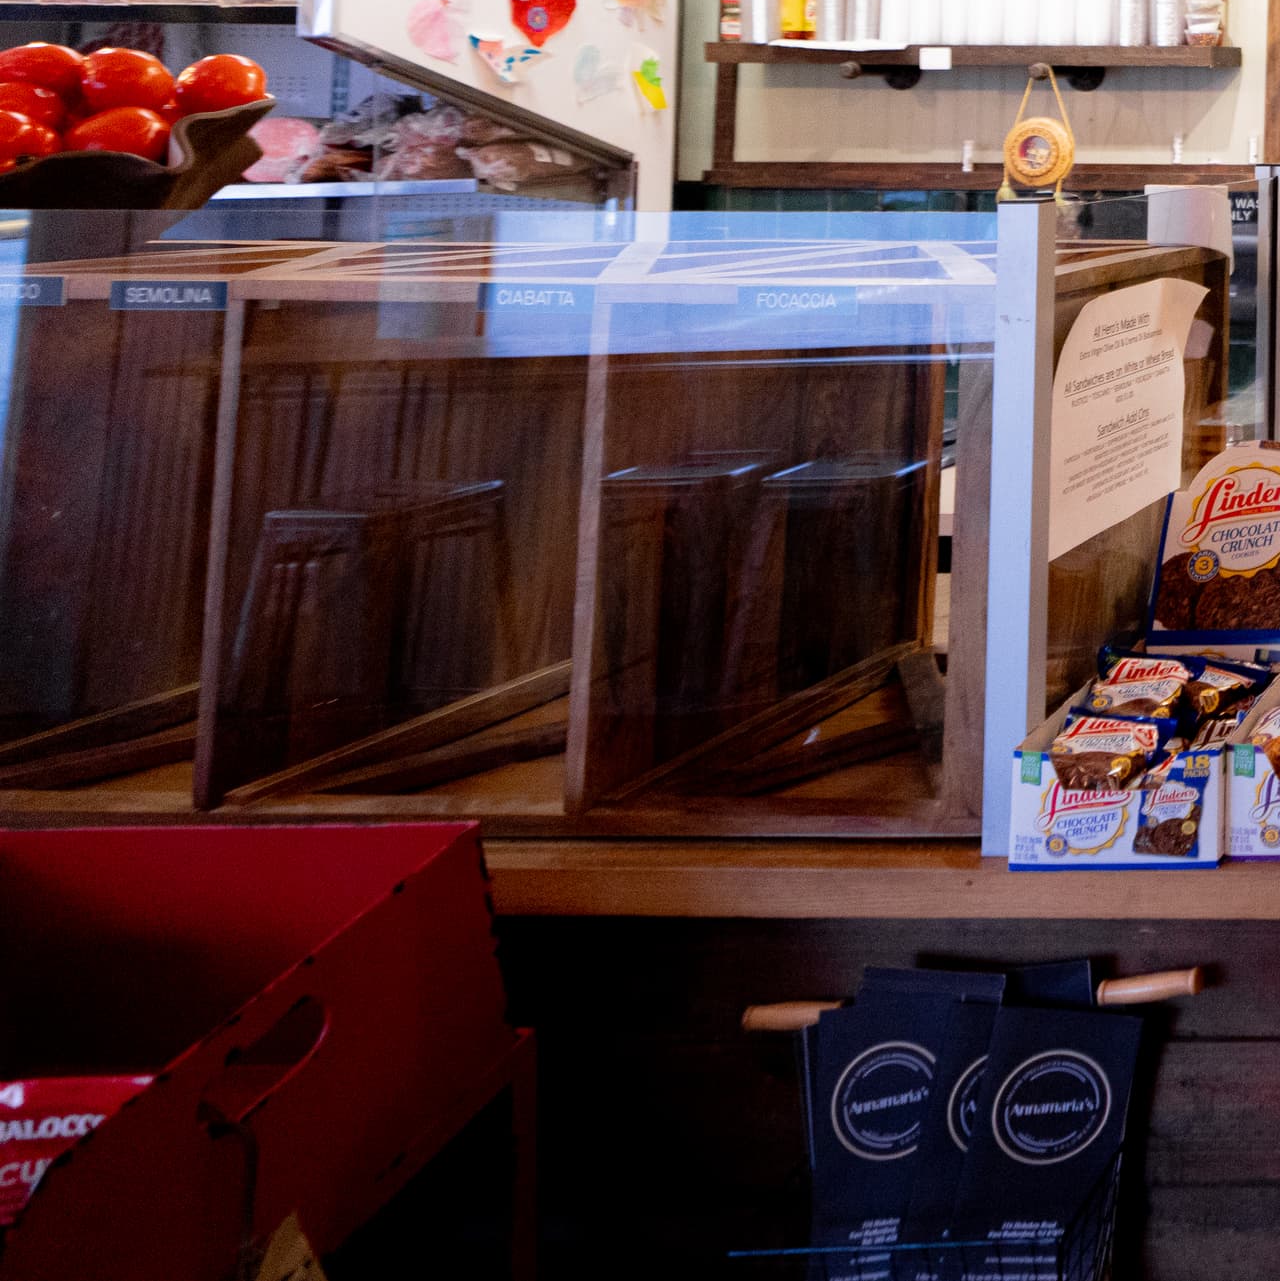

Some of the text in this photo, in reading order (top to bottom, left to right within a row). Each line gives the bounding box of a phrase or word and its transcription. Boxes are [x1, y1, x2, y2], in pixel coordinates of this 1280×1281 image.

[124, 287, 213, 304] SEMOLINA
[497, 289, 575, 306] CIABATTA
[757, 292, 837, 310] FOCACCIA
[1220, 535, 1274, 554] CRUNCH
[1199, 560, 1209, 570] 3
[1185, 756, 1210, 770] 18
[1056, 811, 1118, 830] CHOCOLATE
[1065, 824, 1109, 837] CRUNCH
[1010, 1097, 1095, 1117] Annamaria's
